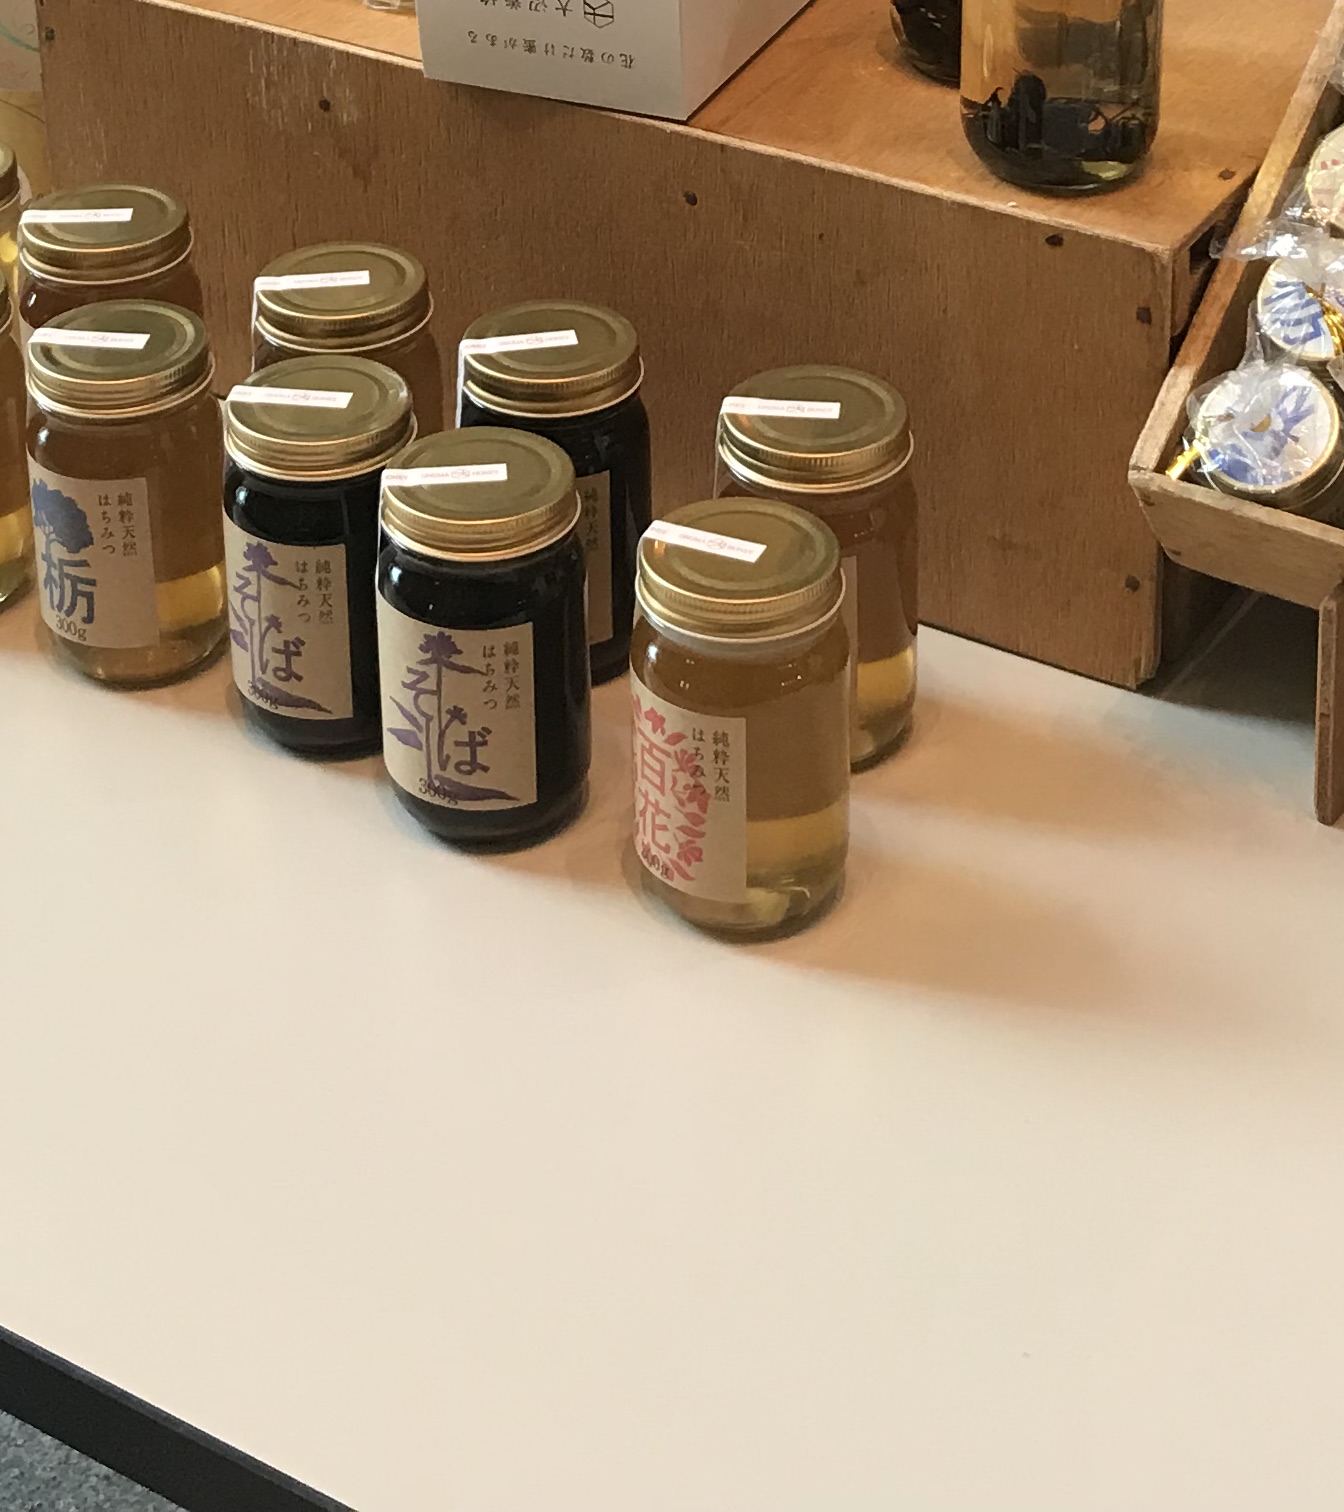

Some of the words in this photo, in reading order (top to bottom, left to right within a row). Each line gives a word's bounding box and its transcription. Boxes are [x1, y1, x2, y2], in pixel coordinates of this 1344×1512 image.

[467, 30, 636, 70] 花の数だけ蜜がある
[98, 494, 116, 555] はちみつ
[117, 491, 138, 557] 純粋天然
[41, 552, 98, 625] 栃
[296, 560, 312, 624] はちみつ
[315, 559, 335, 625] 純粋天然
[56, 614, 88, 642] 300g
[482, 644, 498, 710] はちみつ
[503, 641, 521, 710] 純粋天然
[637, 735, 672, 856] 百花
[712, 729, 731, 803] 純粋天然
